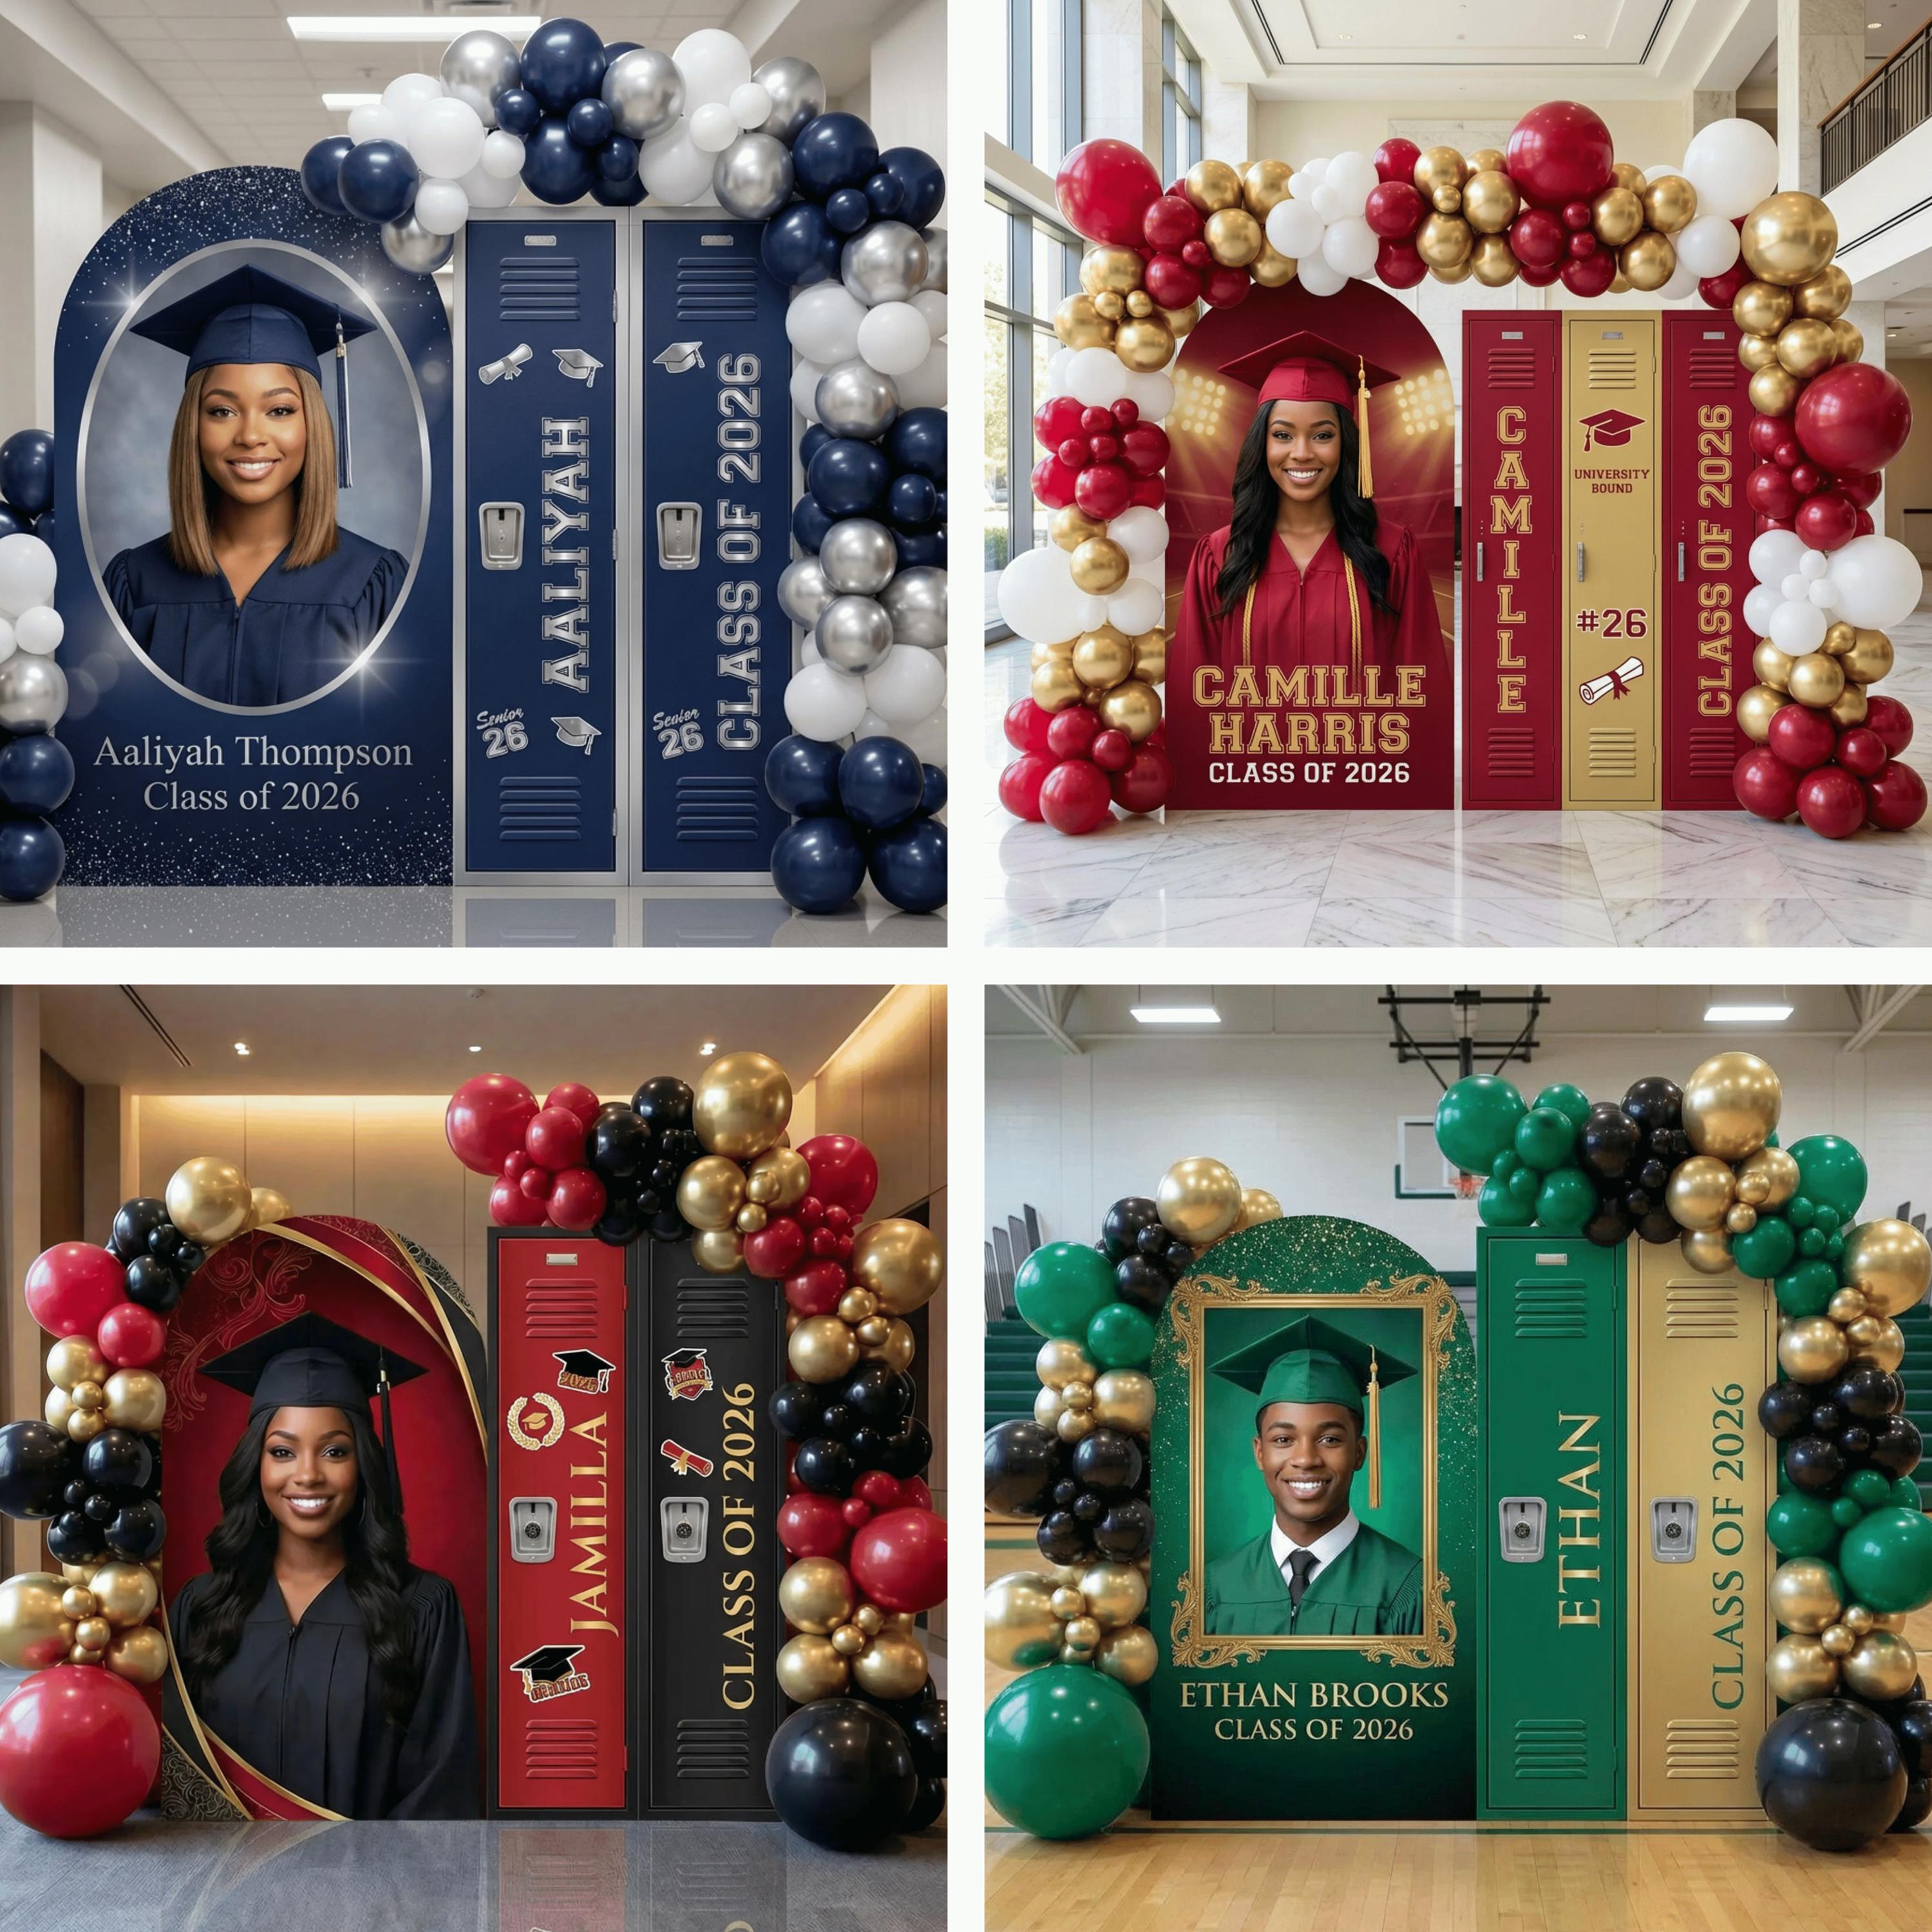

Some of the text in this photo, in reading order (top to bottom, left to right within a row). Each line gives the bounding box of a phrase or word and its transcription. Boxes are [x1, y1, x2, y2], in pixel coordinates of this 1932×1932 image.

[1573, 468, 1651, 480] UNIVERSITY
[1591, 483, 1633, 494] BOUND
[542, 416, 589, 693] AALIYAH
[716, 353, 761, 751] CLASS OF 2026
[1490, 406, 1533, 714] CAMILLE
[1697, 404, 1732, 717] CLASS OF 2026
[1576, 607, 1648, 639] #26
[1192, 665, 1426, 708] CAMILLE
[482, 721, 529, 759] 26
[658, 721, 705, 760] 26
[1209, 712, 1410, 755] HARRIS
[93, 735, 413, 774] Aaliyah Thompson
[1208, 761, 1410, 784] CLASS OF 2026
[143, 781, 360, 811] Class of 2026
[569, 1411, 620, 1638] JAMILLA
[1557, 1410, 1602, 1629] ETHAN
[721, 1382, 756, 1710] CLASS OF 2026
[1711, 1383, 1745, 1710] CLASS OF 2026
[1179, 1681, 1449, 1709] ETHAN BROOKS
[1214, 1718, 1414, 1741] CLASS OF 2026
